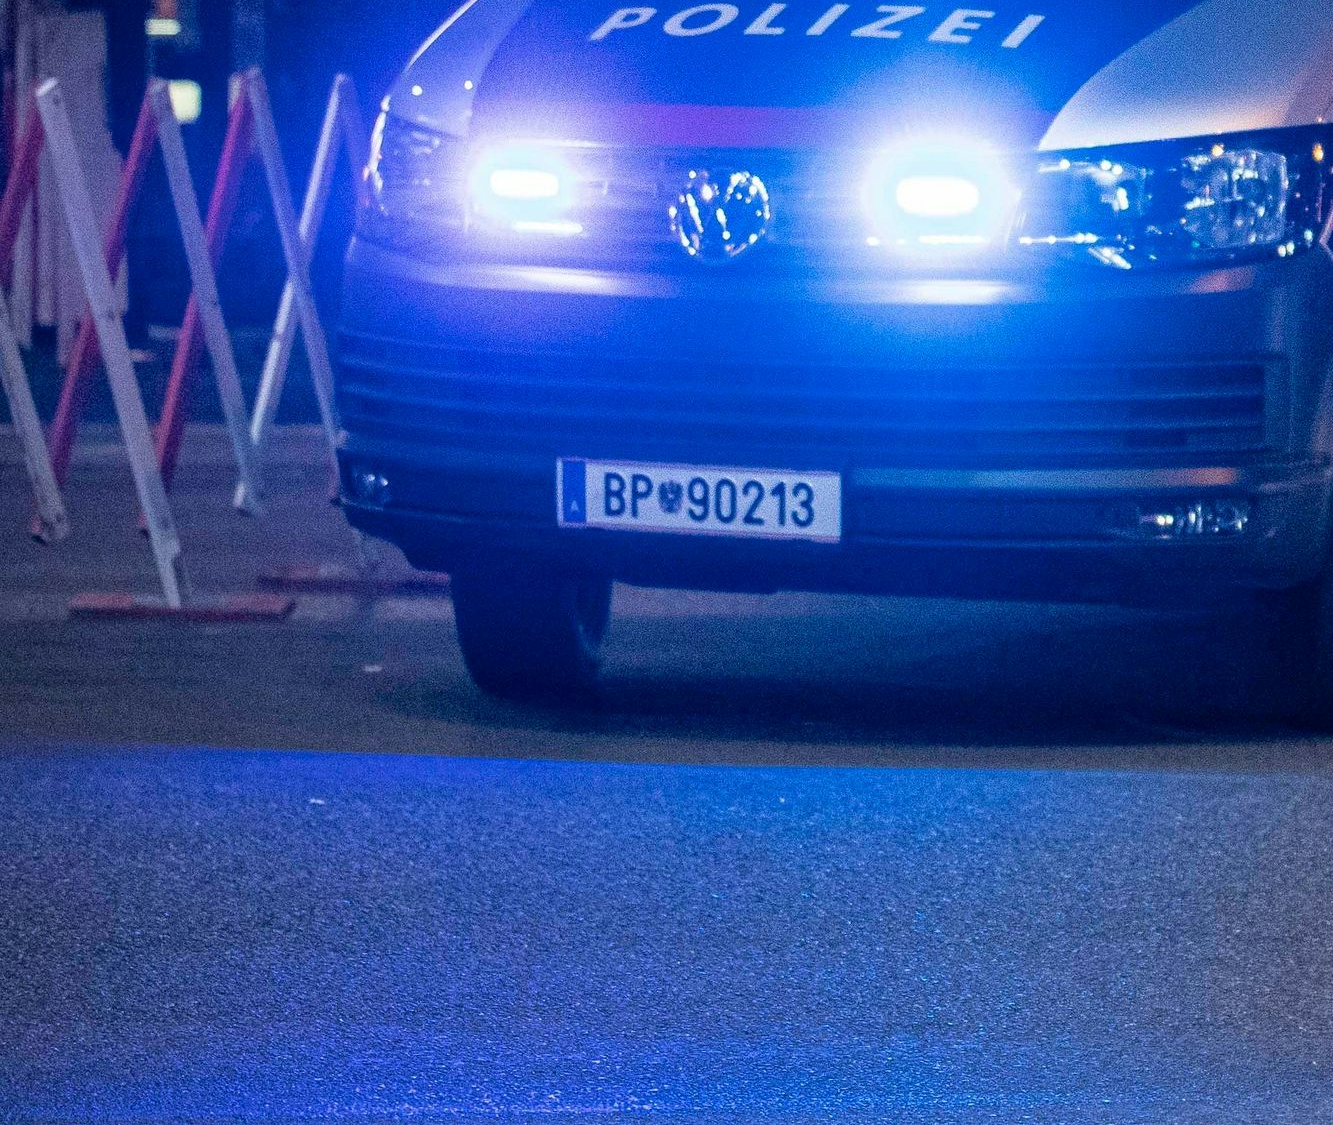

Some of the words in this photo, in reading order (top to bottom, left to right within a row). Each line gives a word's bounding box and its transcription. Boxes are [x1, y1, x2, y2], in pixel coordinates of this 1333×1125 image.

[589, 2, 1046, 48] POLIZEI
[603, 471, 653, 518] BP
[686, 476, 815, 528] 90213
